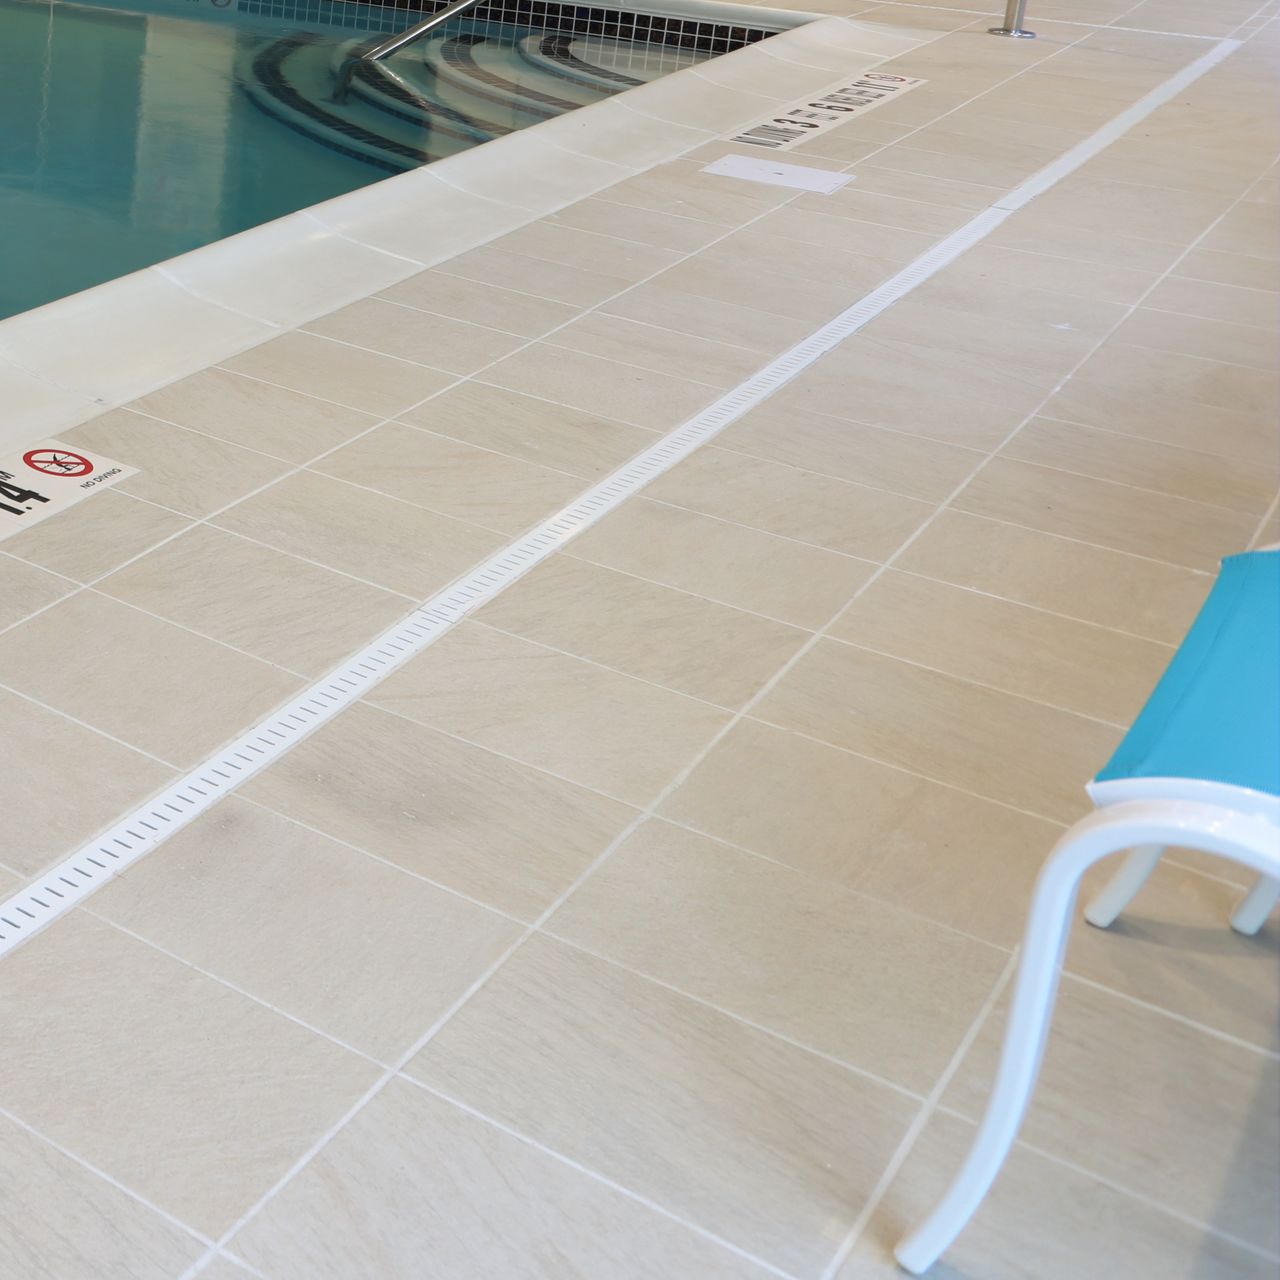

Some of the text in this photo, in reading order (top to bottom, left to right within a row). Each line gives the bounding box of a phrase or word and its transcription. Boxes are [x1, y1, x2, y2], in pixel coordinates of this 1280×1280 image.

[807, 102, 854, 112] 6
[80, 468, 122, 489] NO DIVING
